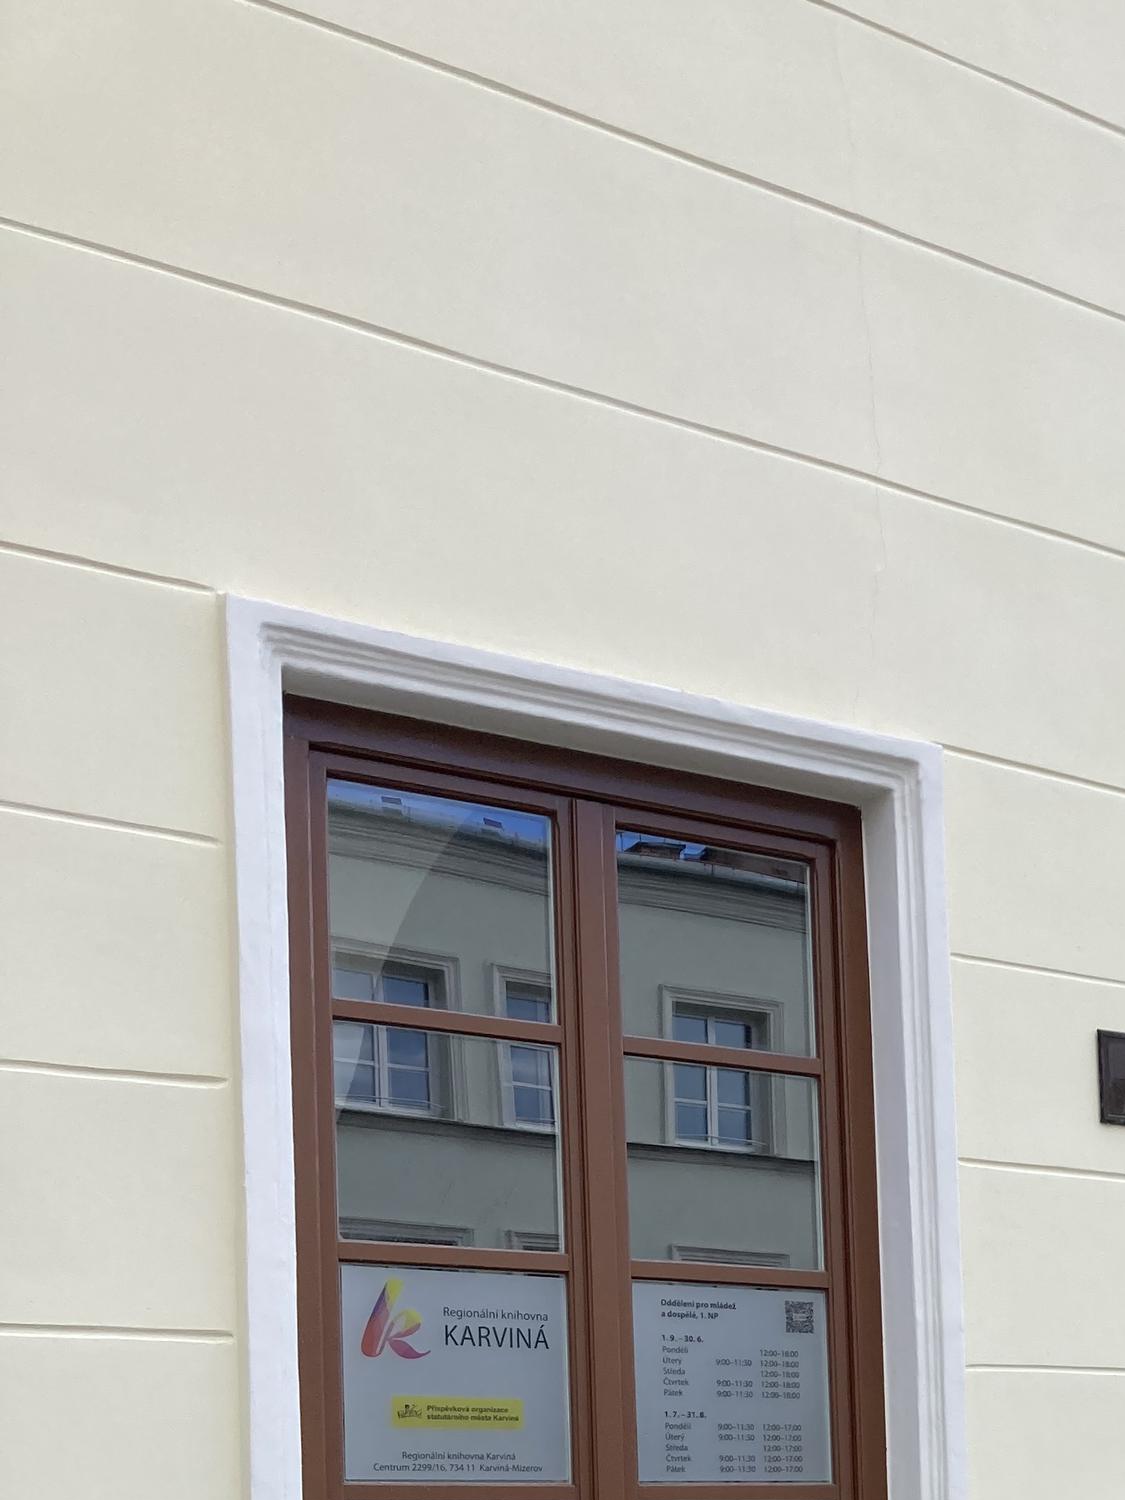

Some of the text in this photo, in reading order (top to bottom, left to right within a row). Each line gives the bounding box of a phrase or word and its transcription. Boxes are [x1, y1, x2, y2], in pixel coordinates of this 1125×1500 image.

[661, 1299, 737, 1310] Oddělení pro mládež
[443, 1306, 549, 1321] Regionální knihovna
[667, 1310, 698, 1320] dospělé,
[445, 1324, 550, 1350] KARVINÁ
[684, 1335, 696, 1343] 30.
[426, 1405, 509, 1414] Příspěvková organizace
[426, 1413, 470, 1421] statutárního
[470, 1413, 492, 1421] města
[402, 1451, 516, 1461] Regionální knihovna Karviná
[373, 1462, 543, 1473] Centrum 2299/16, 734 11 Karviná-Mizerov
